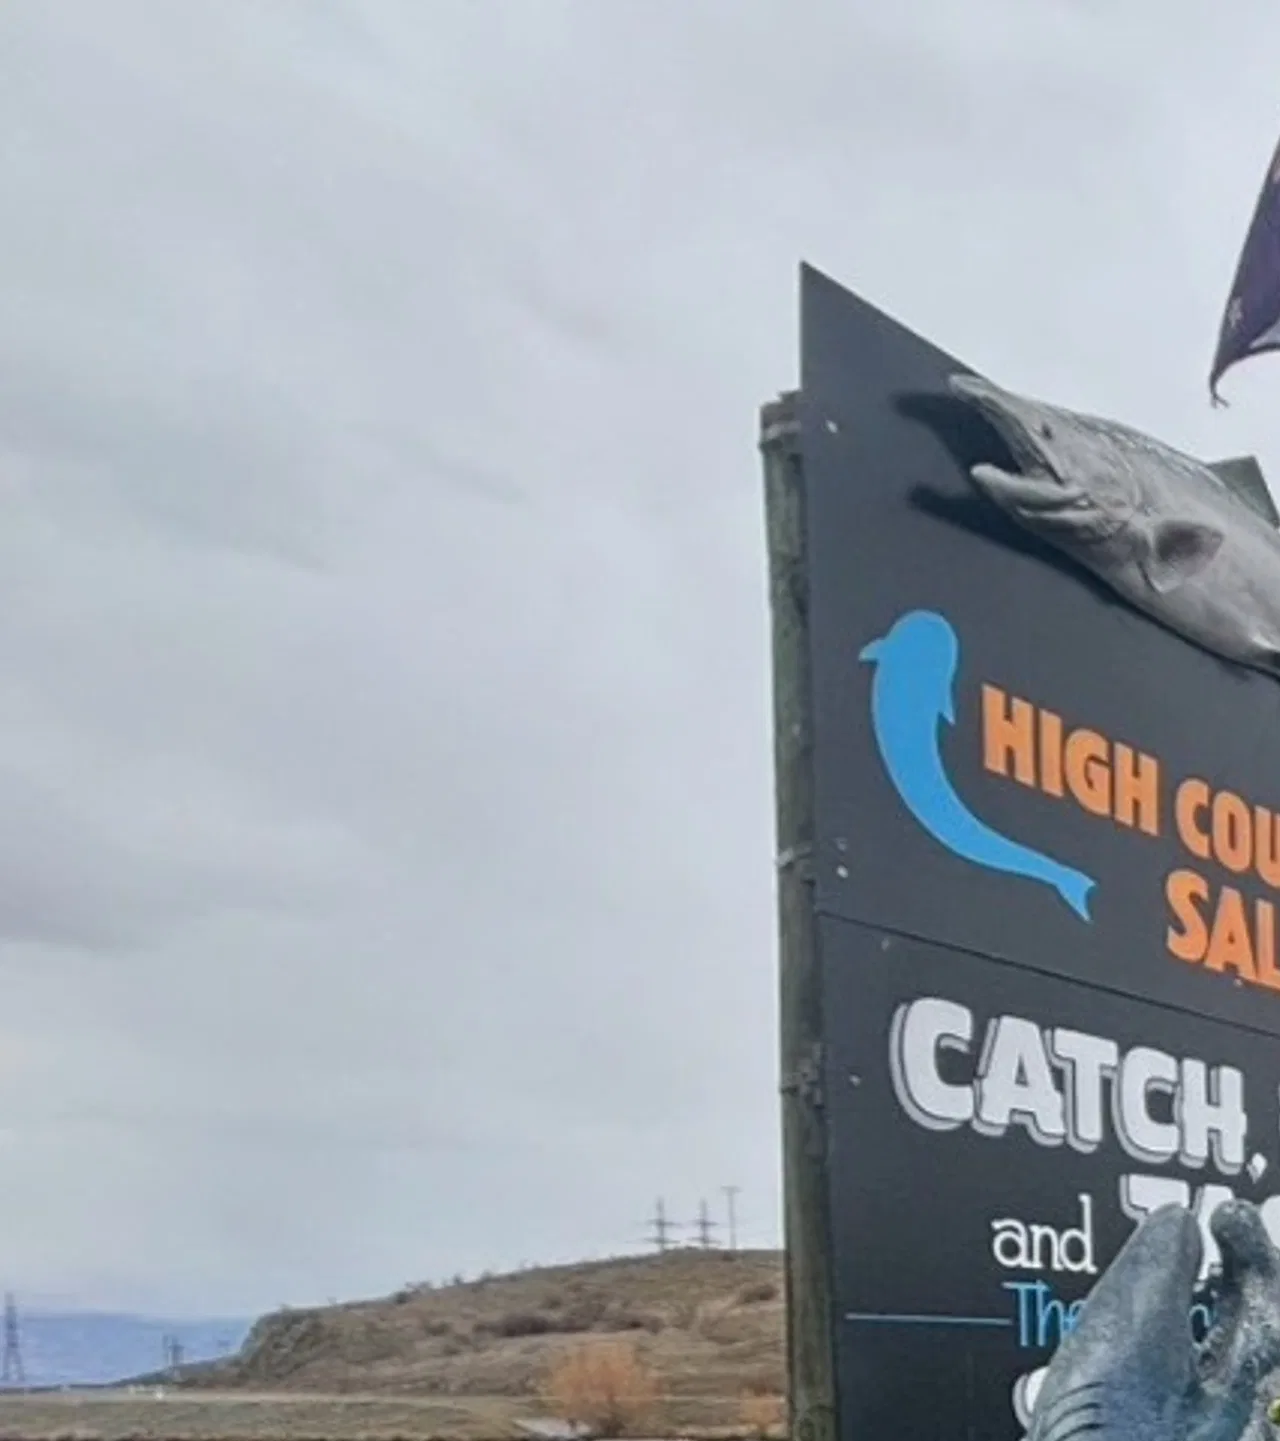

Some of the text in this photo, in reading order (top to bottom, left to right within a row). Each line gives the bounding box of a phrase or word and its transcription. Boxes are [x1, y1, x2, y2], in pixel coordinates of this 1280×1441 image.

[982, 684, 1159, 836] HIGH
[892, 997, 1266, 1183] CATCH,
[991, 1193, 1098, 1274] and
